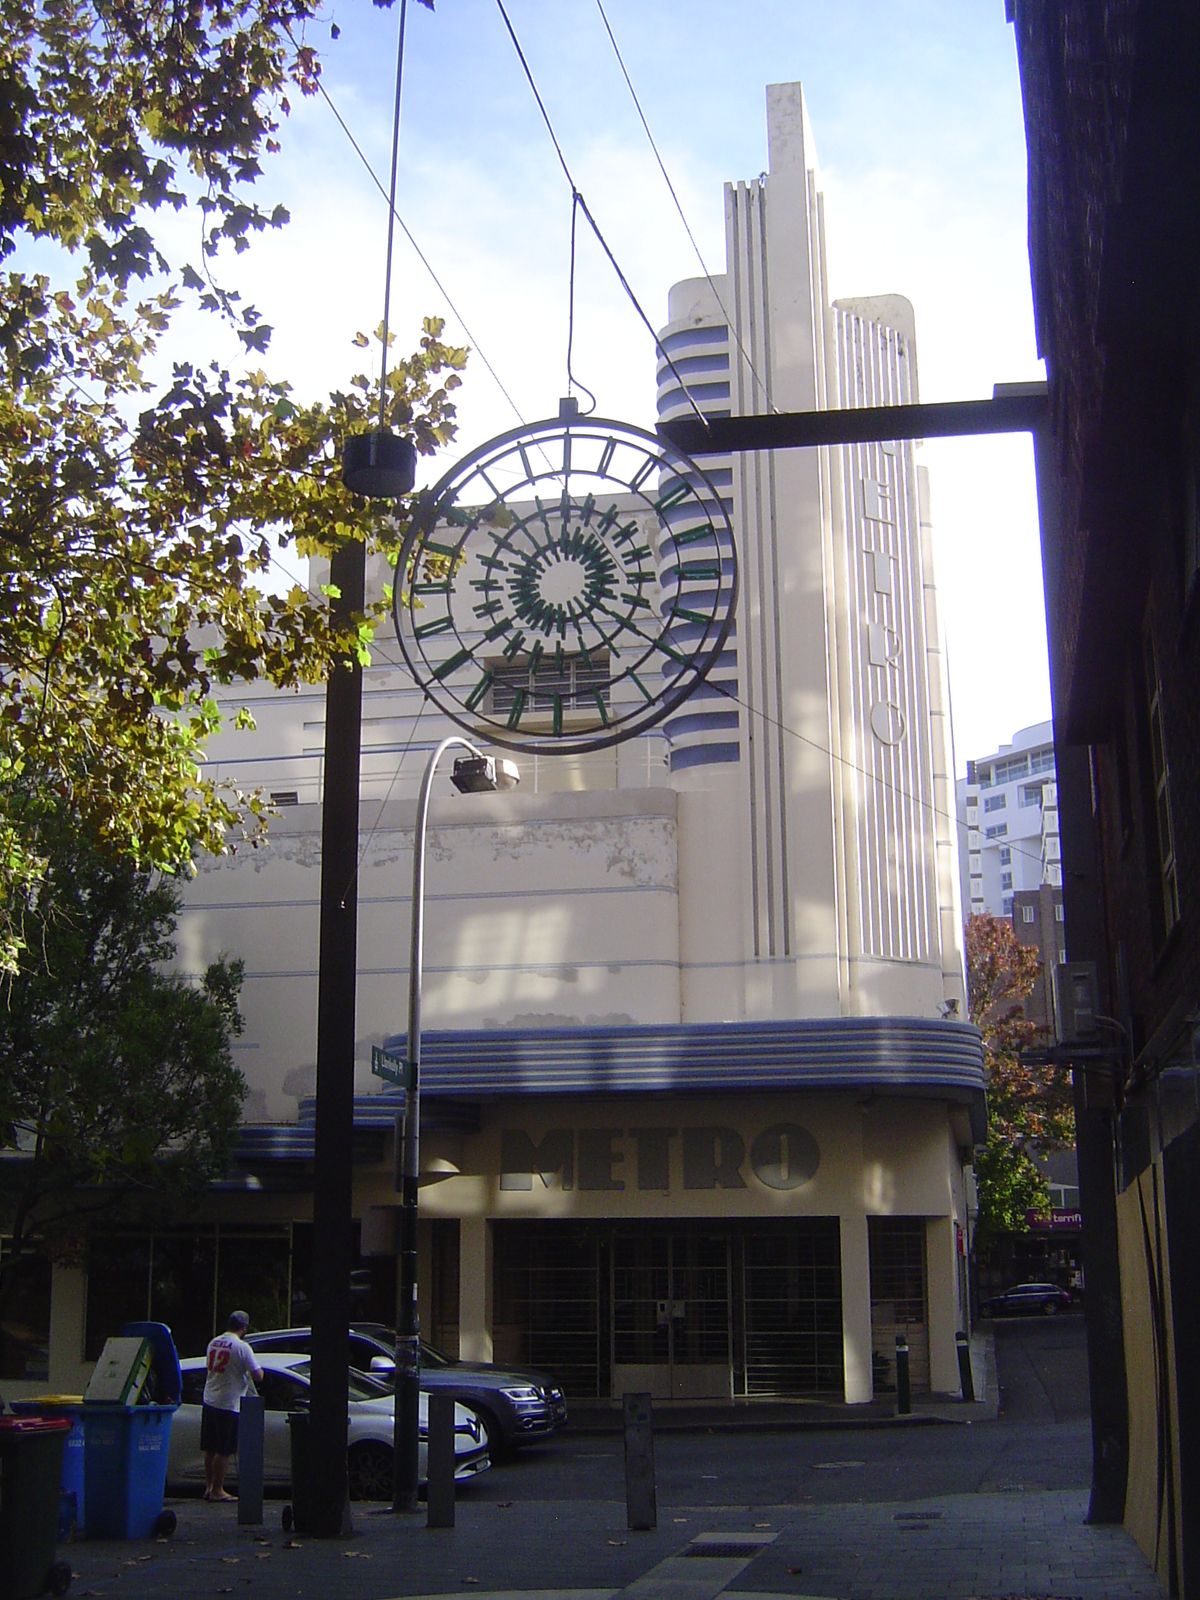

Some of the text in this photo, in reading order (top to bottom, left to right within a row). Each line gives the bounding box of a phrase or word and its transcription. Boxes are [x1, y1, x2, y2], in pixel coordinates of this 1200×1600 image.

[862, 440, 907, 746] ETRO
[500, 1122, 821, 1192] METRO
[1053, 1213, 1082, 1223] terrifi
[208, 1349, 230, 1373] 12
